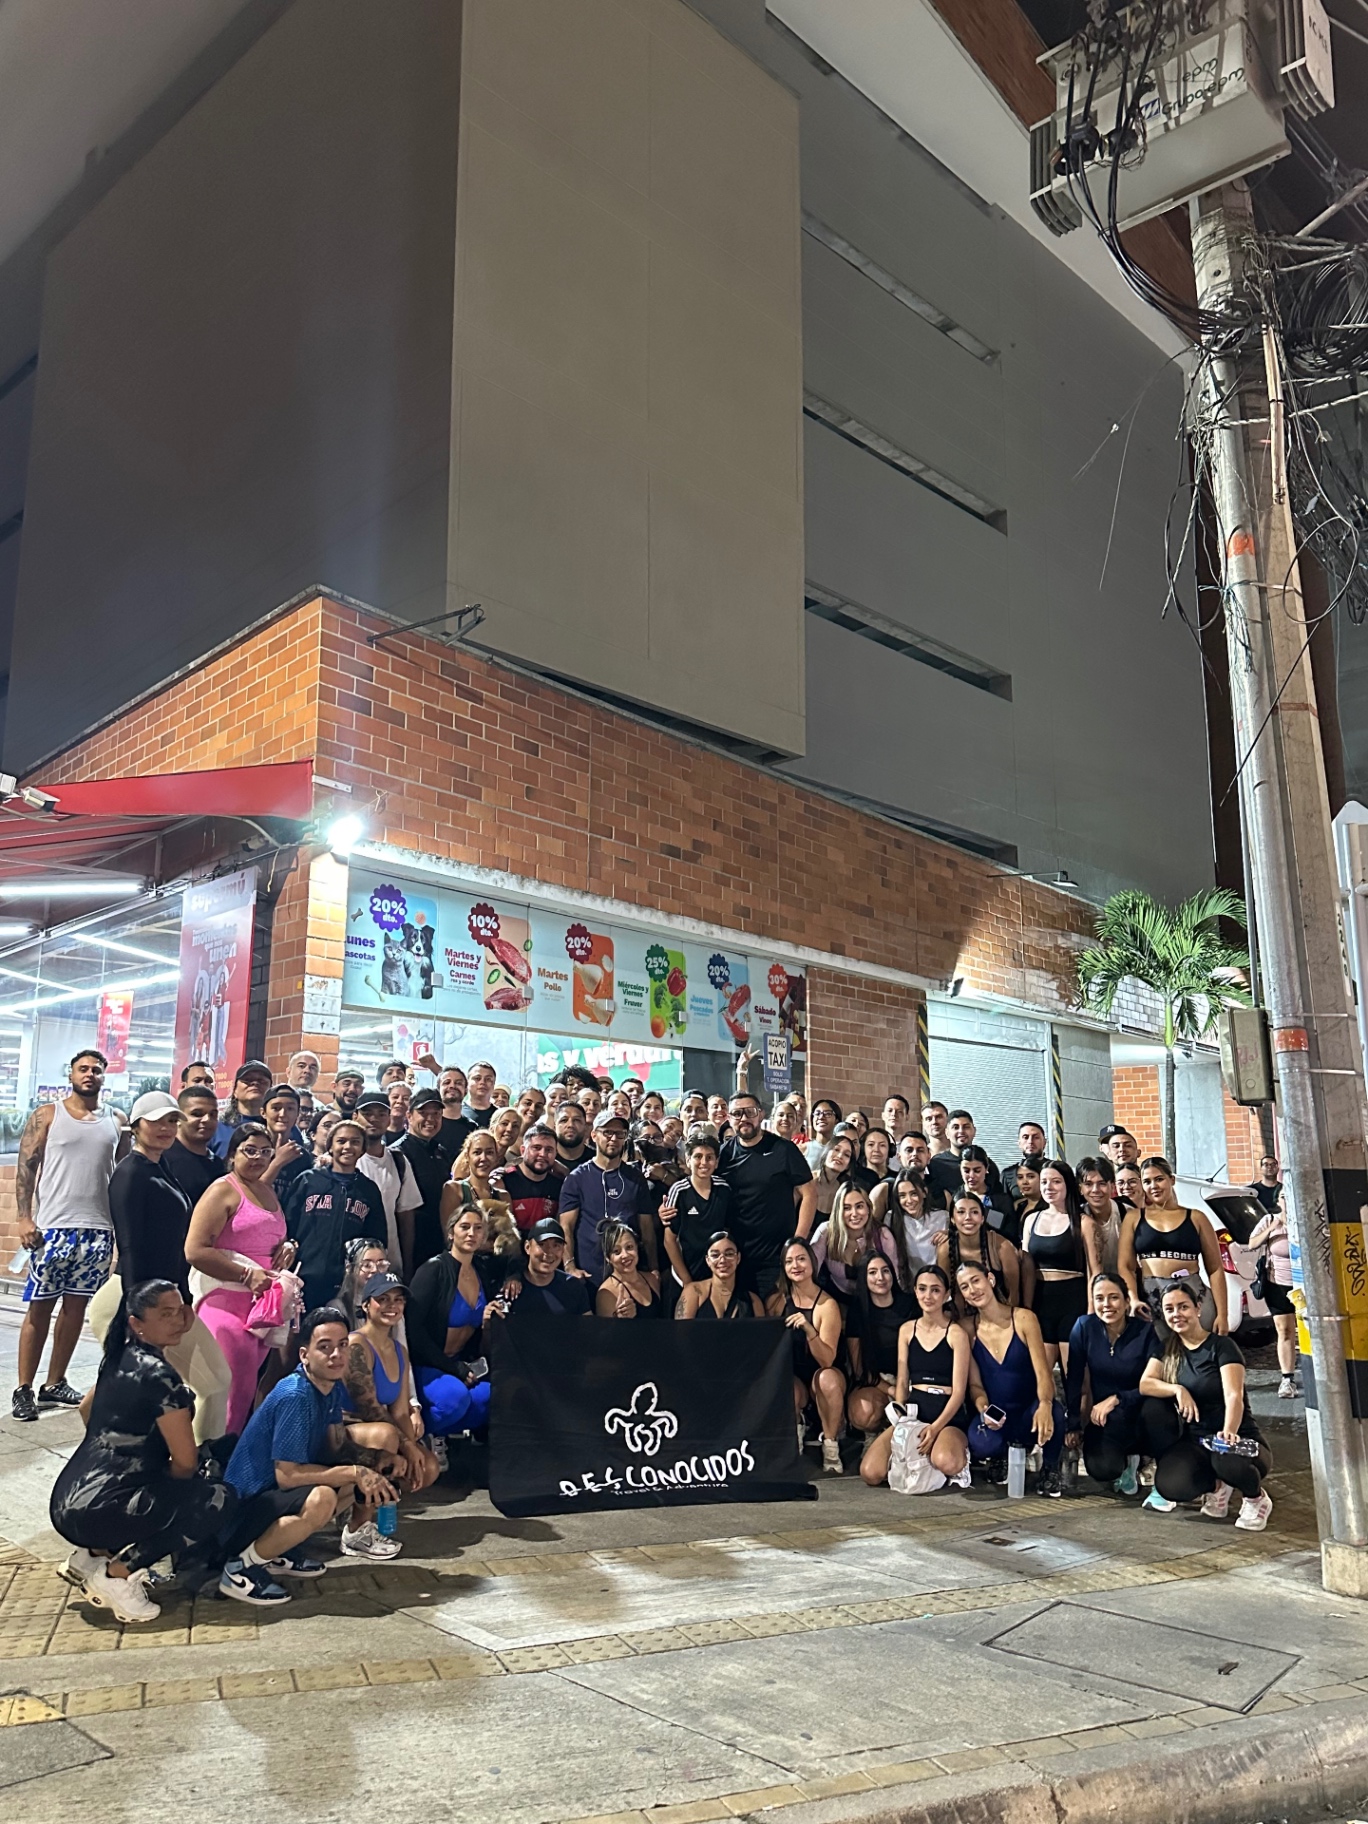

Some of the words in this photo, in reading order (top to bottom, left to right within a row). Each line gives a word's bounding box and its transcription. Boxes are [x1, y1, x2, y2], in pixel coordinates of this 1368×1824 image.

[1183, 58, 1218, 82] epm
[372, 898, 405, 916] 20%
[383, 913, 397, 923] dto.
[470, 915, 498, 929] 10%
[345, 935, 376, 948] unes
[567, 937, 591, 948] 20%
[345, 950, 376, 961] ascotas
[445, 948, 474, 960] Martes
[477, 955, 481, 963] y
[447, 957, 479, 970] Viernes
[647, 957, 668, 968] 25%
[450, 970, 476, 980] Carnes
[538, 967, 568, 981] Martes
[709, 965, 729, 976] 20%
[769, 974, 788, 985] 30%
[544, 982, 562, 991] Pollo
[618, 981, 645, 991] Miércoles
[622, 988, 643, 997] Viernes
[690, 995, 713, 1005] Jueves
[754, 1006, 776, 1016] Sábado
[769, 1039, 786, 1048] ACOPIO
[768, 1052, 786, 1067] TAXI
[1160, 1251, 1196, 1260] SECRET
[559, 1440, 755, 1496] DESCONOCIDOS
